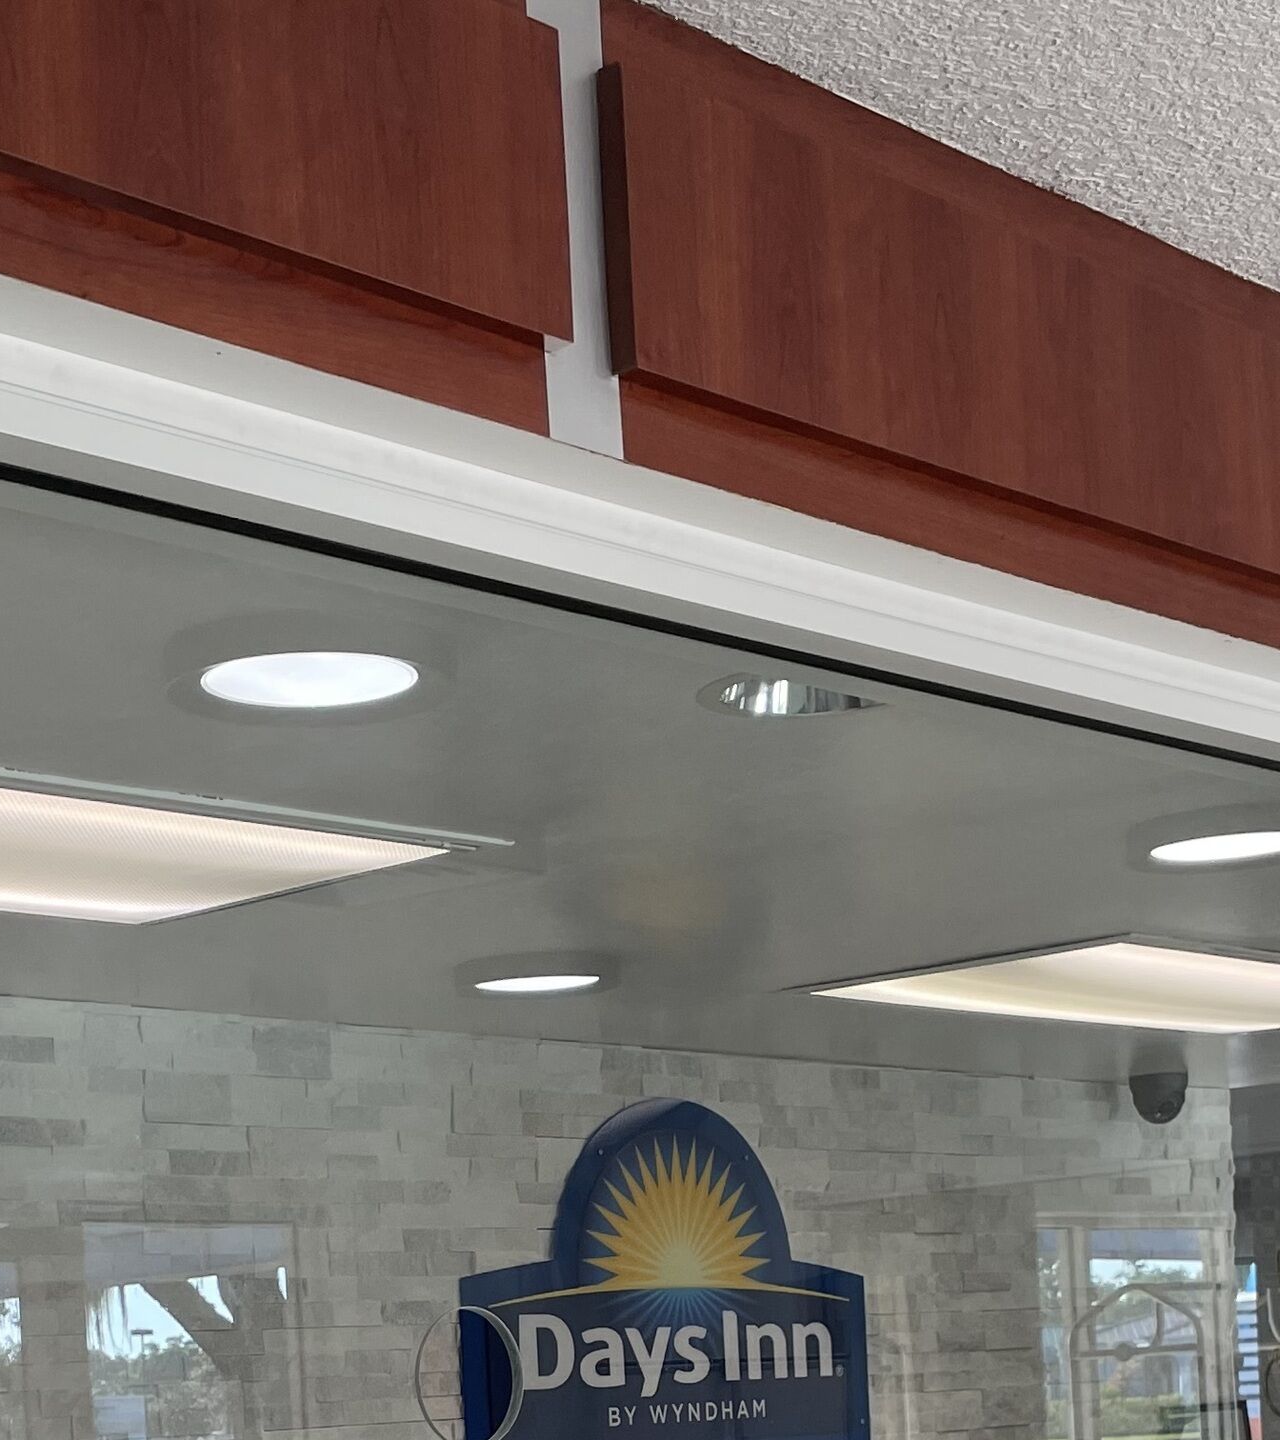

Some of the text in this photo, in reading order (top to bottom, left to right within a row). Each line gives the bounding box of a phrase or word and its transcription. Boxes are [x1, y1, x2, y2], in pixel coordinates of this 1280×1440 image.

[519, 1310, 834, 1398] Days Inn
[608, 1399, 767, 1428] BY WYNDHAM
